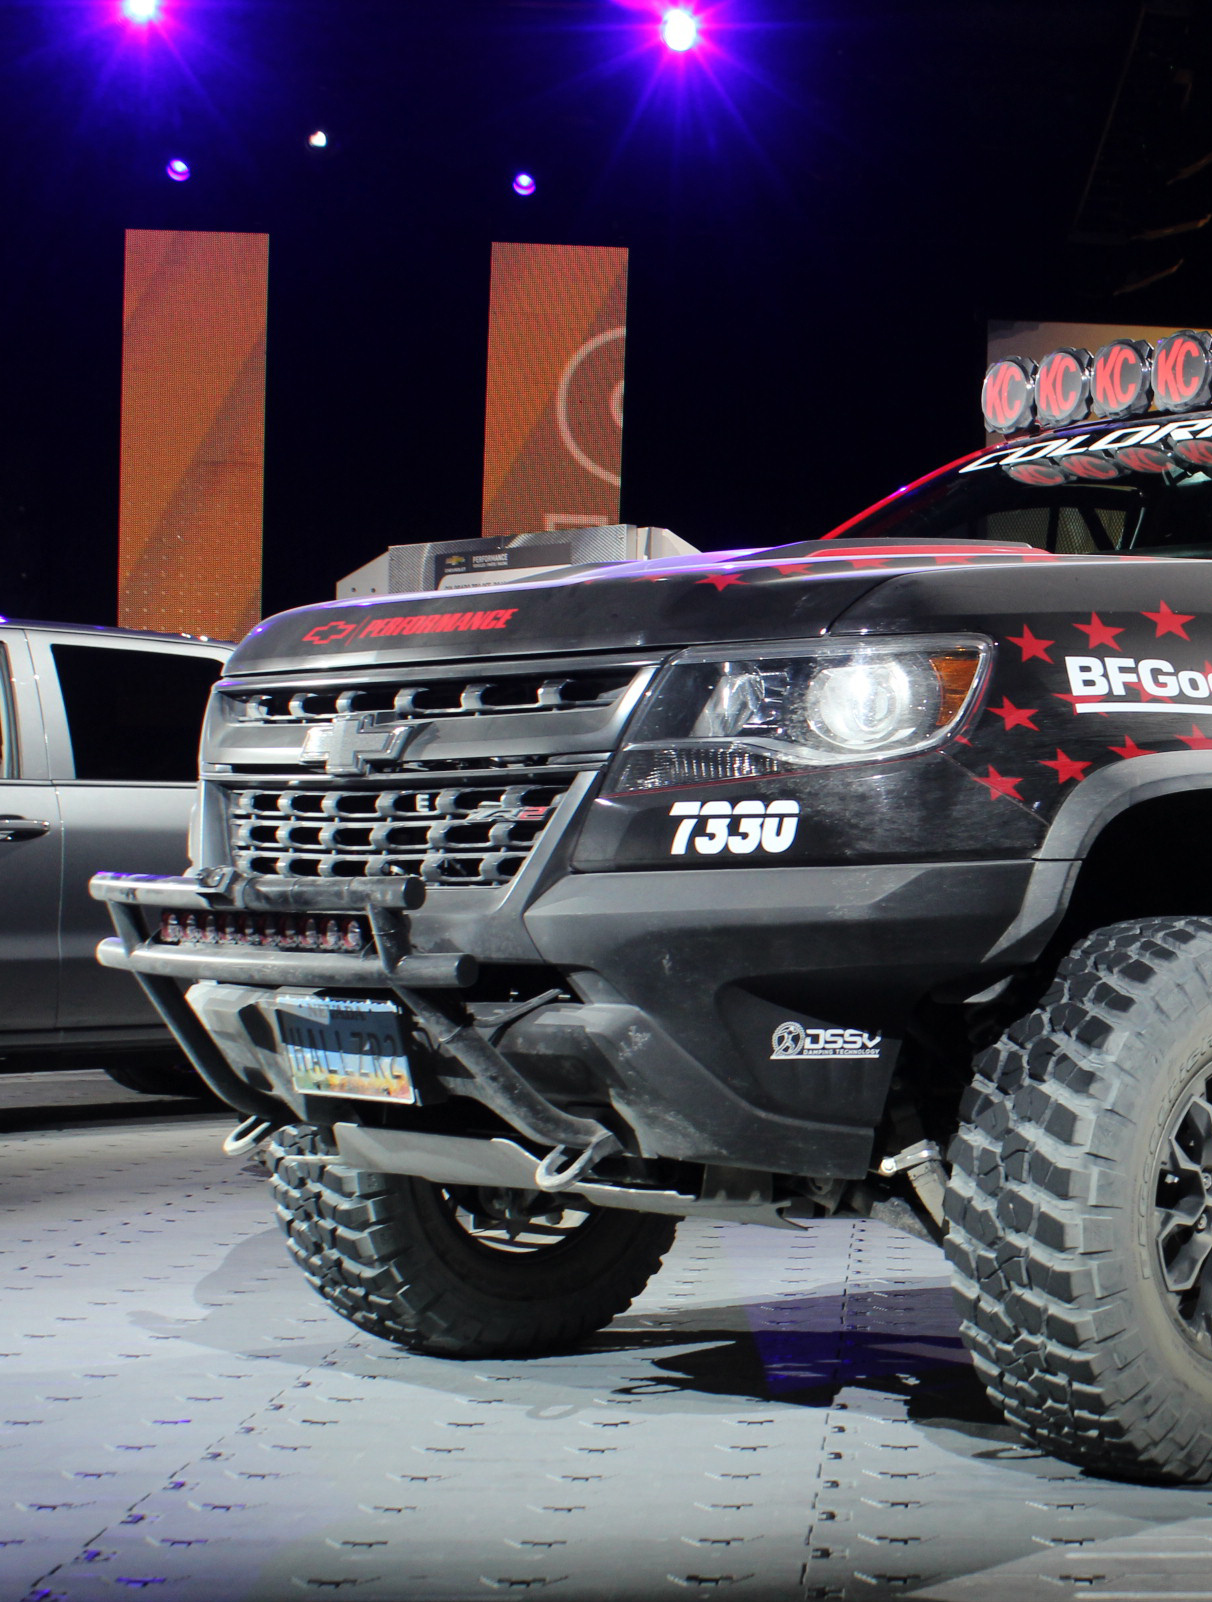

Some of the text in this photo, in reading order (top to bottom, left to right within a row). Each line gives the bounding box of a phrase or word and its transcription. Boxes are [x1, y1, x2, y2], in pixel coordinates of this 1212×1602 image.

[986, 363, 1021, 424] KC
[1039, 354, 1077, 416] KC
[1096, 345, 1137, 409] KC
[1157, 339, 1200, 401] KC
[360, 608, 519, 638] PERFORMANCE
[669, 800, 800, 855] 7330
[804, 1029, 881, 1049] DSSV
[835, 1047, 880, 1055] TECHNOLOGY
